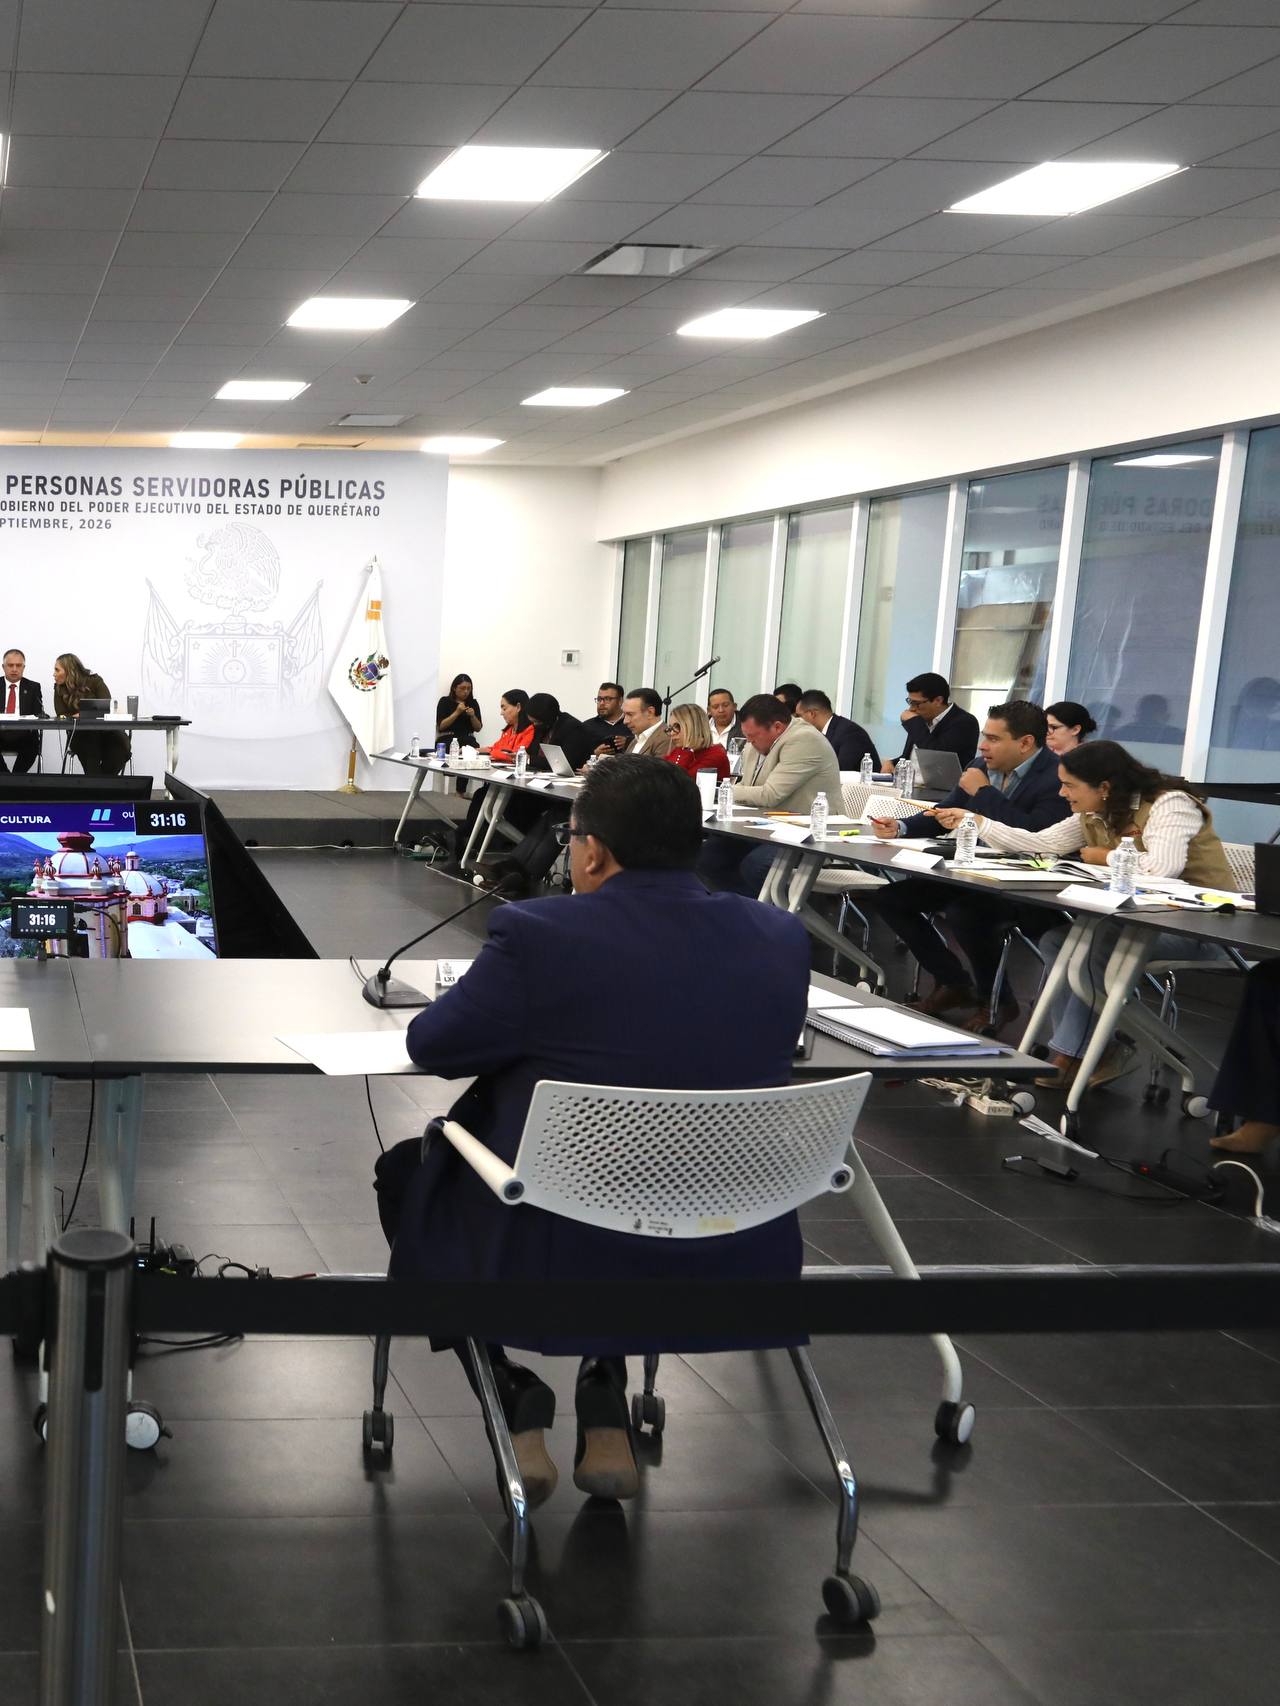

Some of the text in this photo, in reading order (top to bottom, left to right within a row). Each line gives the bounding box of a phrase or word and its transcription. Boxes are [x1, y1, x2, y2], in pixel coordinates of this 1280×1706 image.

[6, 475, 122, 496] PERSONAS
[132, 477, 270, 498] SERVIDORAS
[280, 473, 386, 500] PÚBLICAS
[60, 500, 84, 512] DEL
[88, 501, 130, 513] PODER
[135, 502, 201, 514] EJECUTIVO
[206, 503, 230, 515] DEL
[234, 503, 282, 515] ESTADO
[287, 504, 303, 515] DE
[307, 502, 381, 517] QUERÉTARO
[78, 518, 112, 530] 2026
[0, 815, 52, 824] CULTURA
[150, 813, 187, 827] 31:16
[29, 913, 56, 926] 31:16
